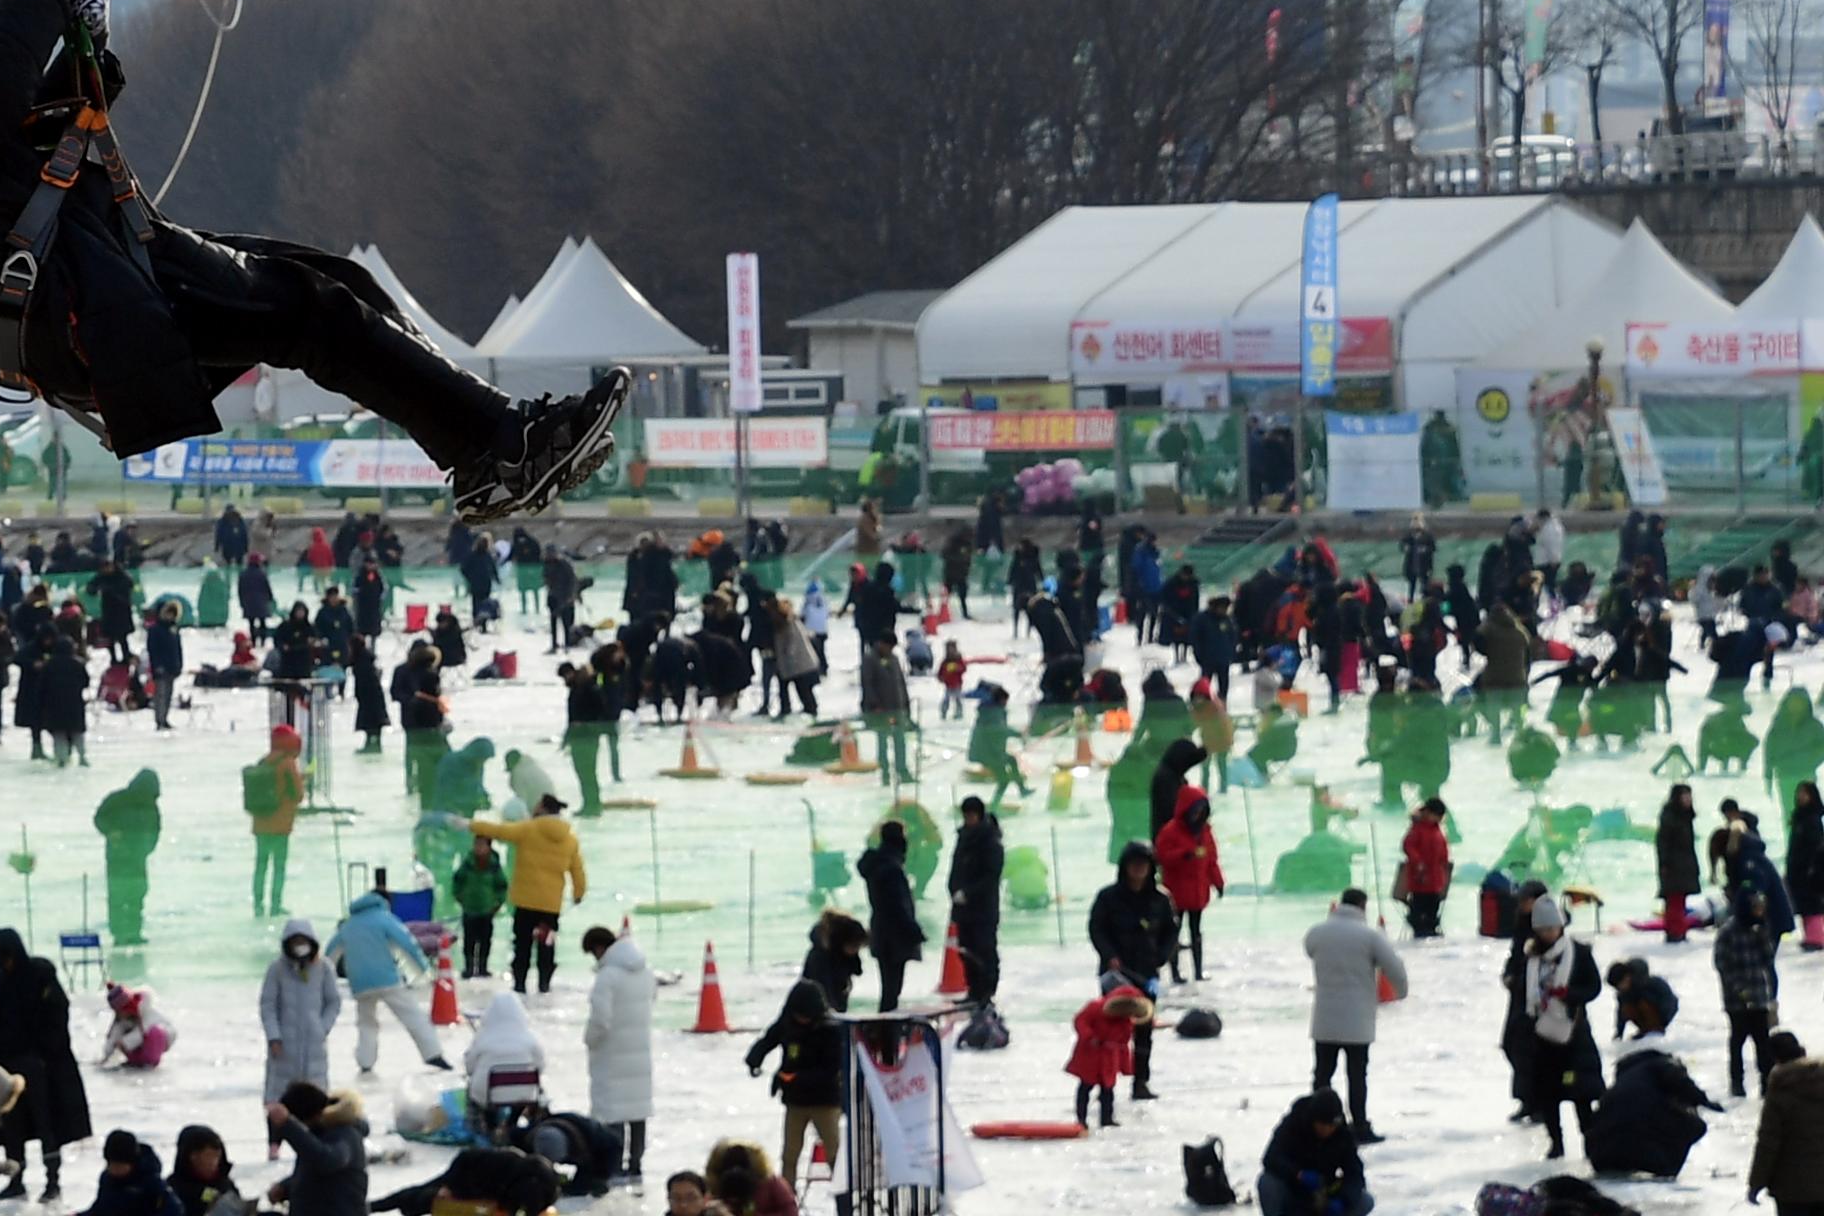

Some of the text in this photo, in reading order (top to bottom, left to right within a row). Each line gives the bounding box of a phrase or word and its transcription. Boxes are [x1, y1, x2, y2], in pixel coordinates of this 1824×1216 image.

[1311, 289, 1327, 314] 4
[1112, 331, 1164, 360] 산천어
[1170, 329, 1221, 360] 회센터
